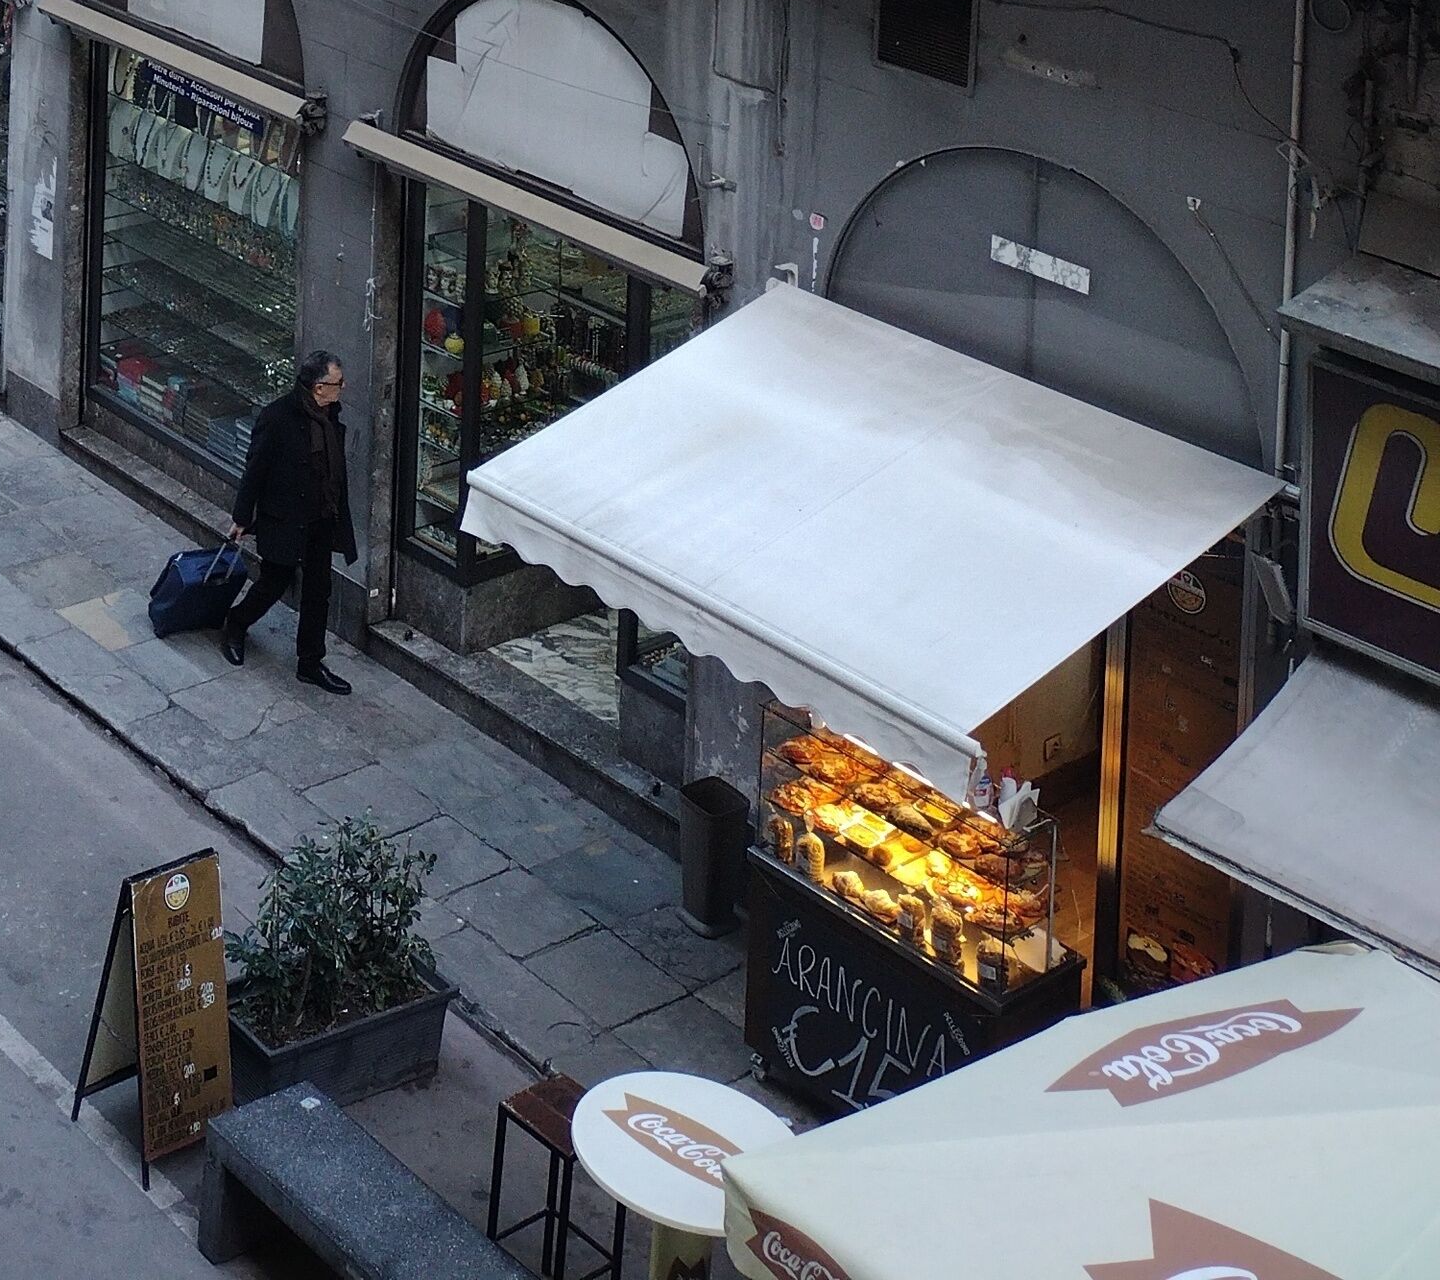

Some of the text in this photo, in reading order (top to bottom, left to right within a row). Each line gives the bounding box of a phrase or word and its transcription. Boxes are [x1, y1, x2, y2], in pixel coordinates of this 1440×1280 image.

[153, 73, 185, 96] Minuteria
[190, 92, 230, 118] Riparazioni
[230, 111, 254, 130] bijoux
[168, 71, 185, 84] dure
[190, 81, 223, 102] Accessori
[224, 97, 236, 109] per
[772, 937, 946, 1077] ARANCINA
[1101, 1011, 1302, 1092] Coca-Cola
